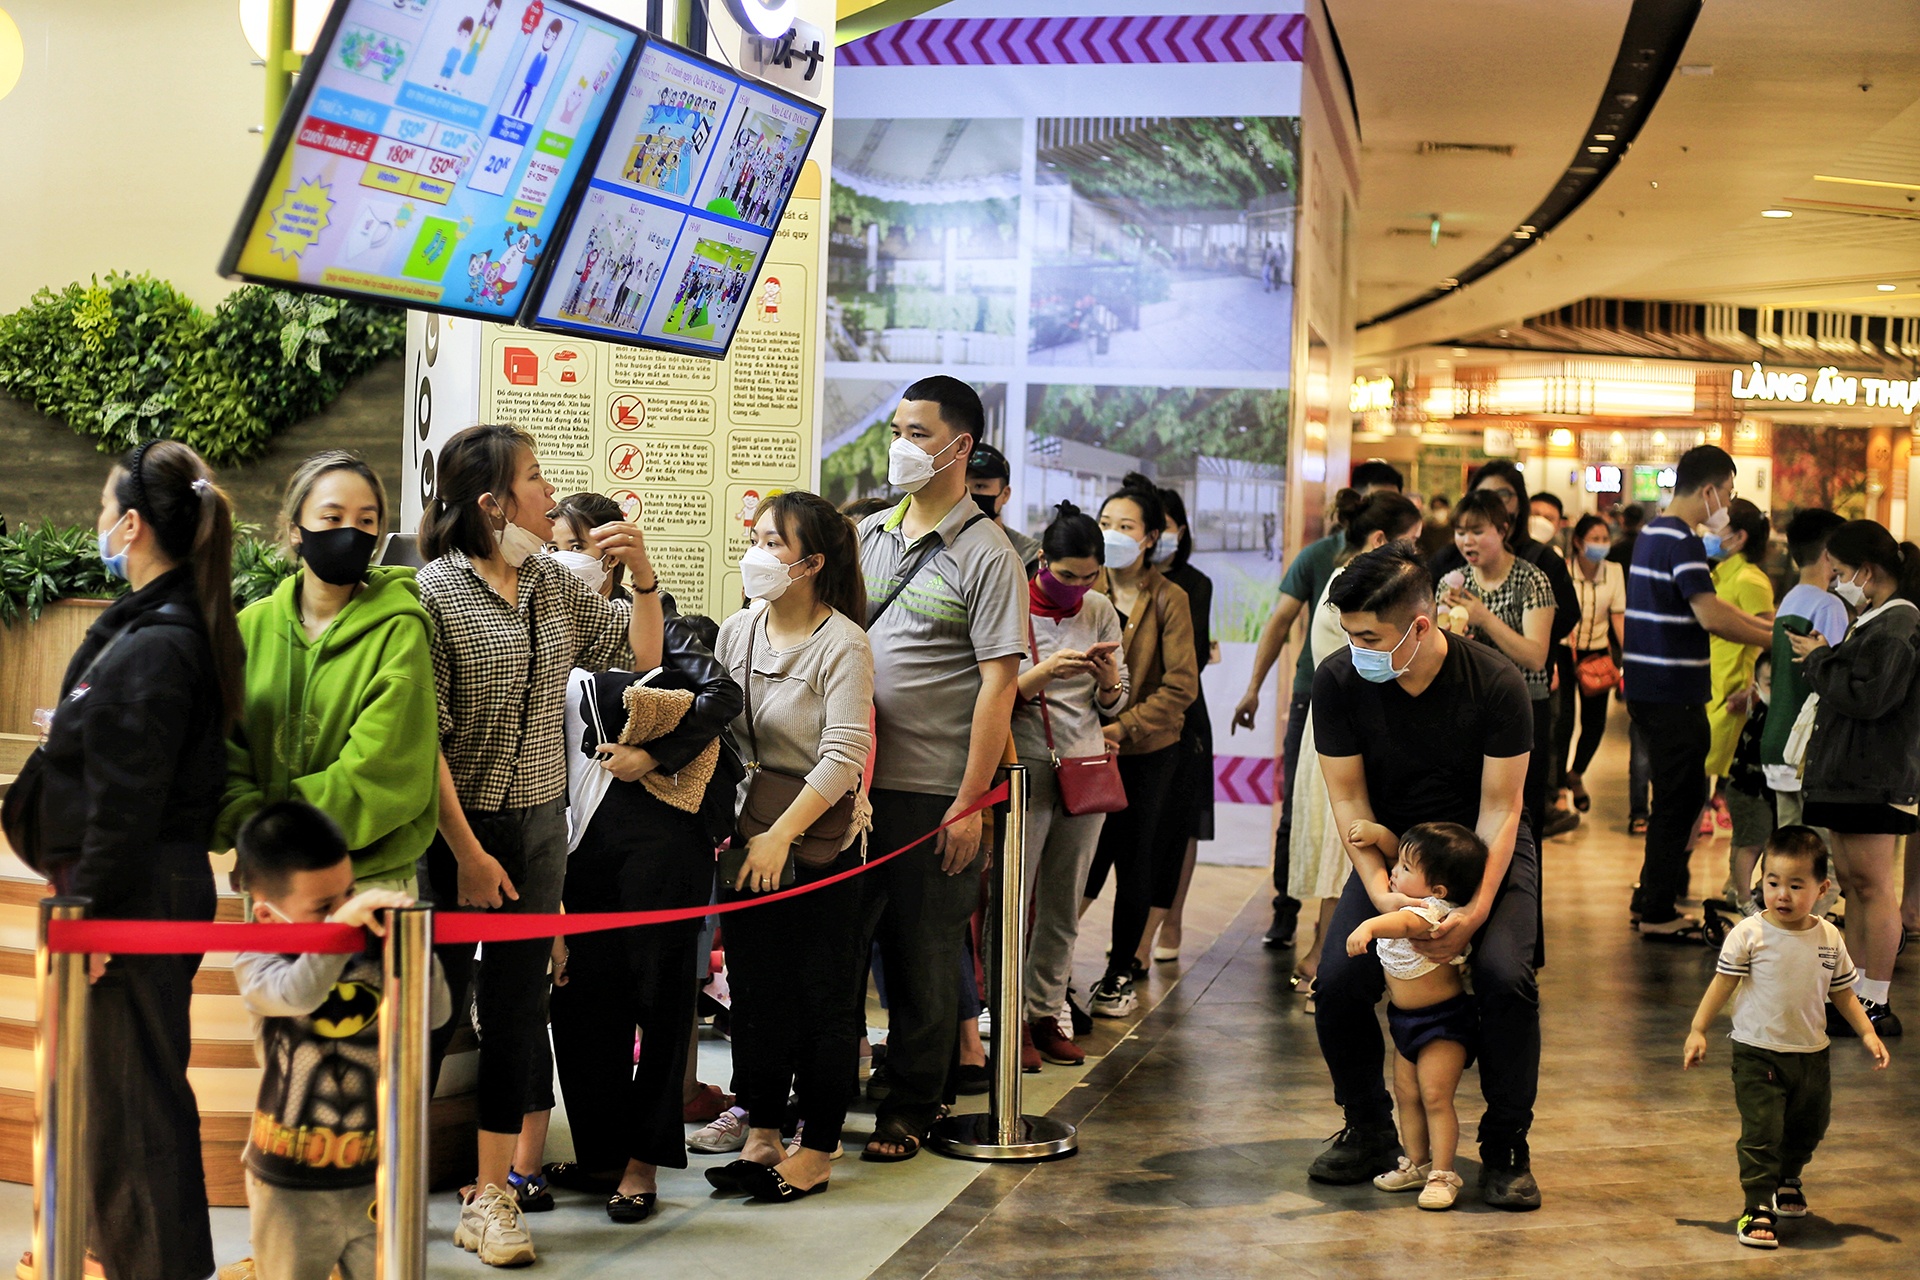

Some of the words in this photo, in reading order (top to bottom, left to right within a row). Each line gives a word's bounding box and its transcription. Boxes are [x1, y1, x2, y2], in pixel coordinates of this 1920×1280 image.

[301, 124, 325, 144] CUỐI
[324, 130, 350, 151] TUẦN
[419, 181, 445, 195] Member
[514, 205, 537, 218] Member
[798, 211, 808, 220] cả
[776, 229, 790, 239] nội
[792, 231, 809, 240] quy
[1731, 361, 1808, 402] LÀNG
[1811, 366, 1858, 406] ẨM
[689, 397, 698, 405] đồ
[748, 392, 755, 401] bị
[685, 414, 697, 422] của
[771, 436, 780, 445] hộ
[656, 441, 668, 451] đẩy
[749, 443, 759, 451] sát
[665, 450, 678, 458] vào
[672, 458, 680, 466] có
[645, 465, 653, 473] để
[664, 465, 676, 475] đẩy
[644, 474, 656, 483] quý
[690, 493, 706, 502] quá
[660, 507, 673, 515] cần
[693, 509, 706, 518] hạn
[643, 515, 655, 523] chế
[657, 515, 665, 523] để
[686, 517, 697, 526] gây
